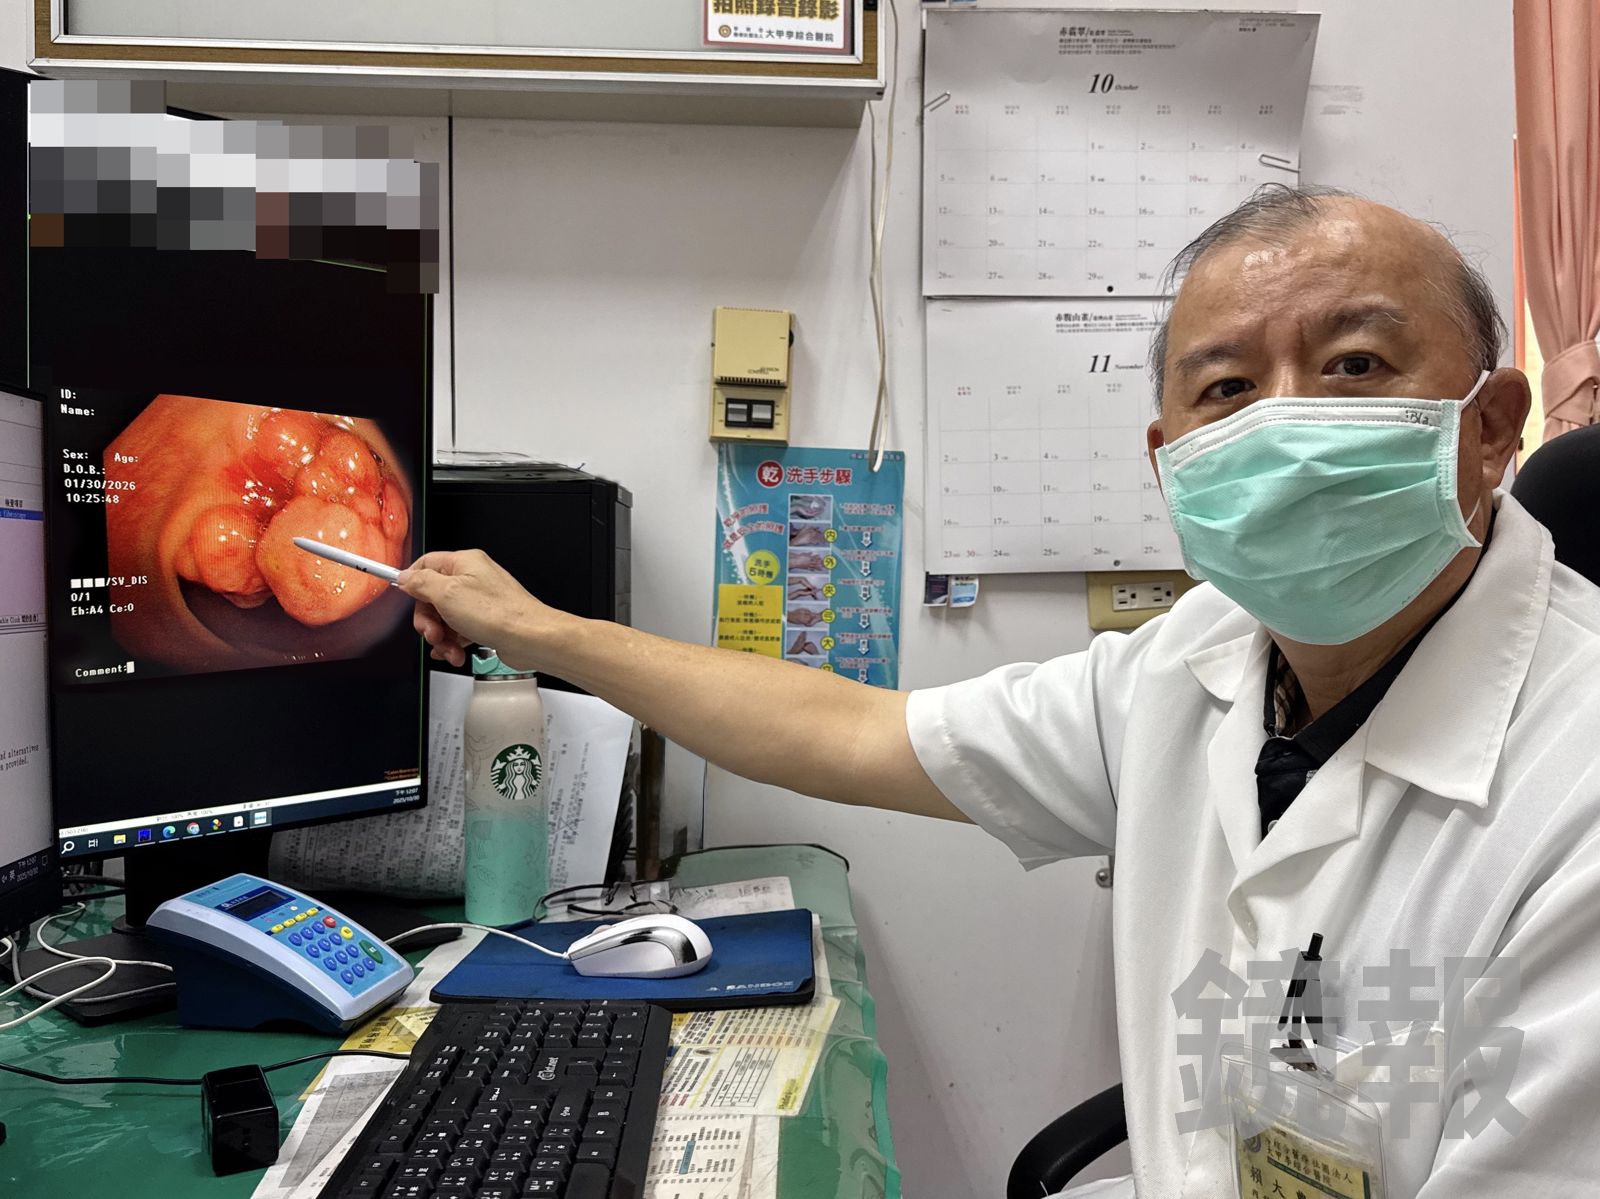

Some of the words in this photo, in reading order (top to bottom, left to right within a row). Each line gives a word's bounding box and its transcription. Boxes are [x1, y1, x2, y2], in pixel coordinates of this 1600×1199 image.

[1088, 73, 1114, 94] 10
[1089, 354, 1111, 373] 11
[60, 389, 76, 399] ID:
[60, 404, 95, 416] Name:
[62, 449, 88, 460] Sex:
[114, 453, 138, 463] Age:
[63, 463, 106, 475] D.O.B.:
[761, 466, 779, 483] 乾
[786, 466, 853, 485] 洗手步驟
[64, 478, 136, 490] 01/30/2026
[66, 493, 120, 503] 10:25:48
[70, 592, 90, 602] 0/1
[71, 605, 104, 616] Eh:A4
[75, 662, 127, 677] Comment:
